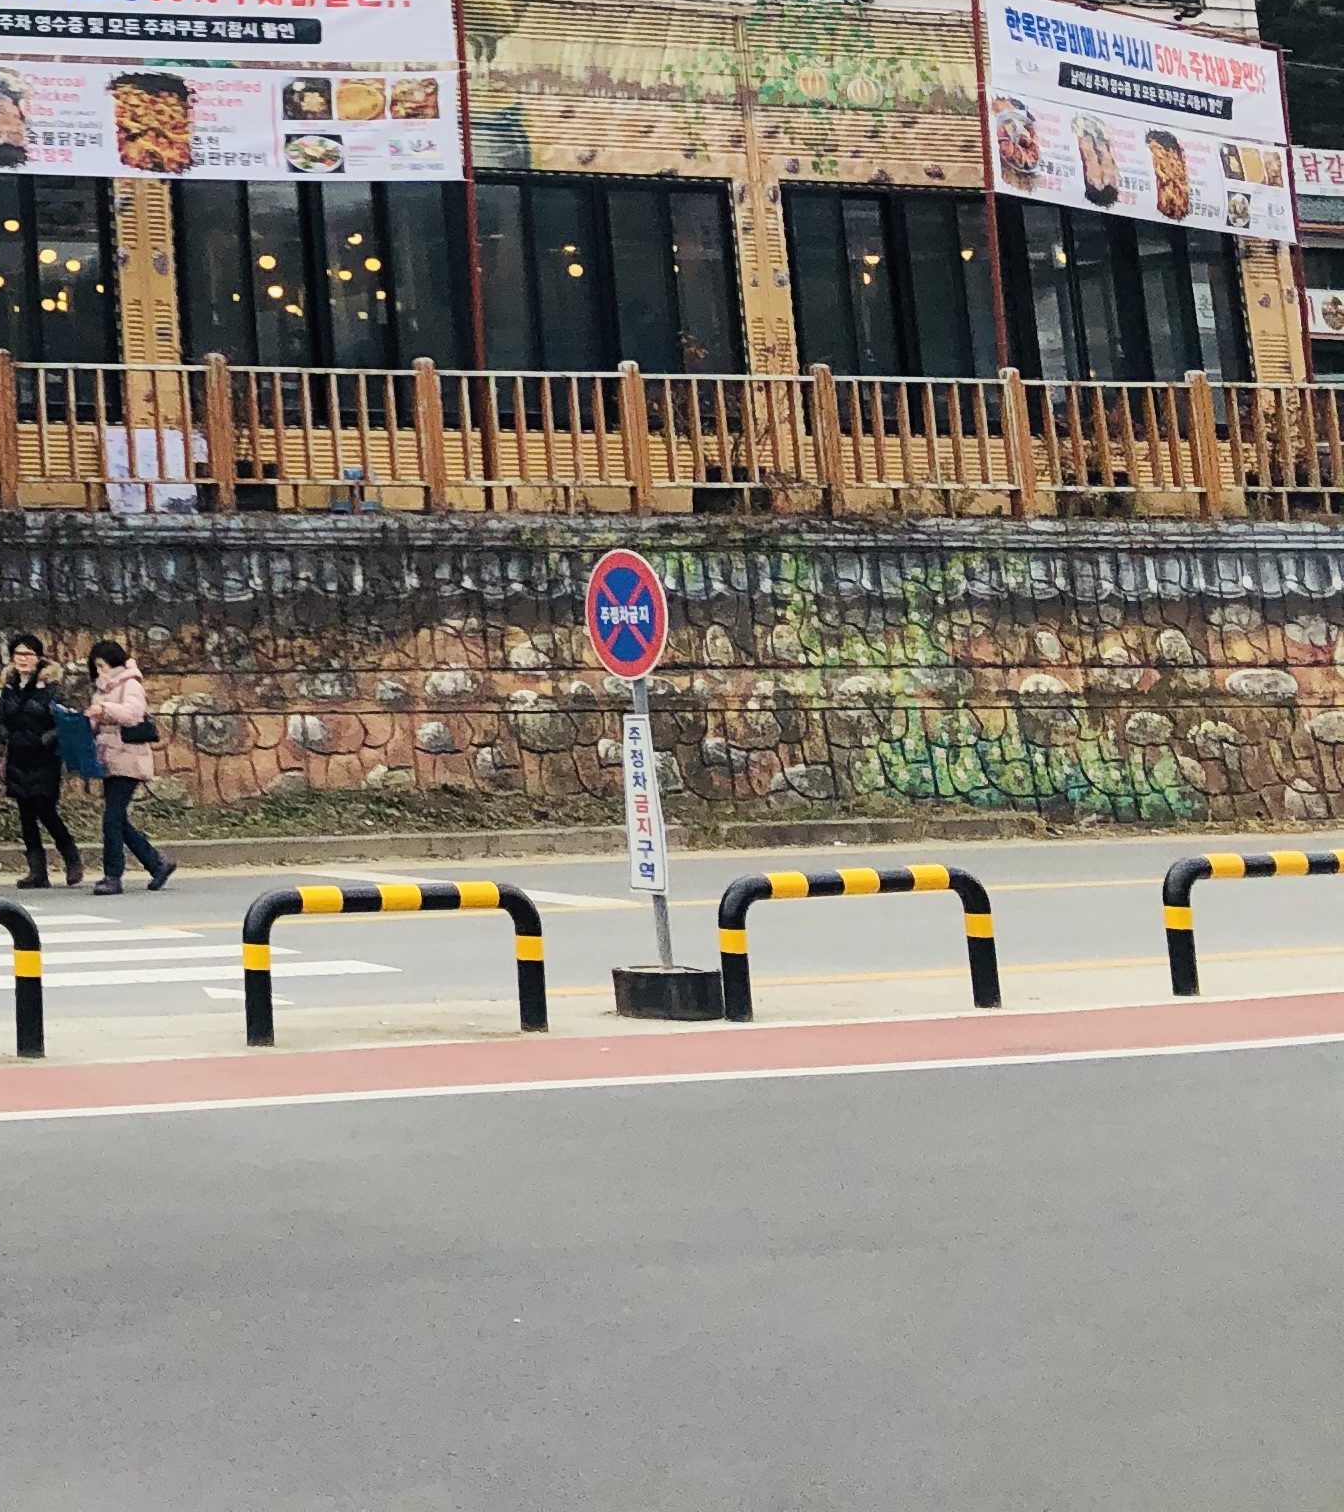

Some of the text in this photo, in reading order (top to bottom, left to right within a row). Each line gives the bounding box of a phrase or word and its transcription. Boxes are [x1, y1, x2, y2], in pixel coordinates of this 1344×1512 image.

[34, 15, 85, 34] 영수증
[107, 18, 140, 36] 모든
[1154, 43, 1189, 79] 50%
[600, 604, 650, 625] 주정차금지
[628, 726, 656, 883] 주정차금지구역
